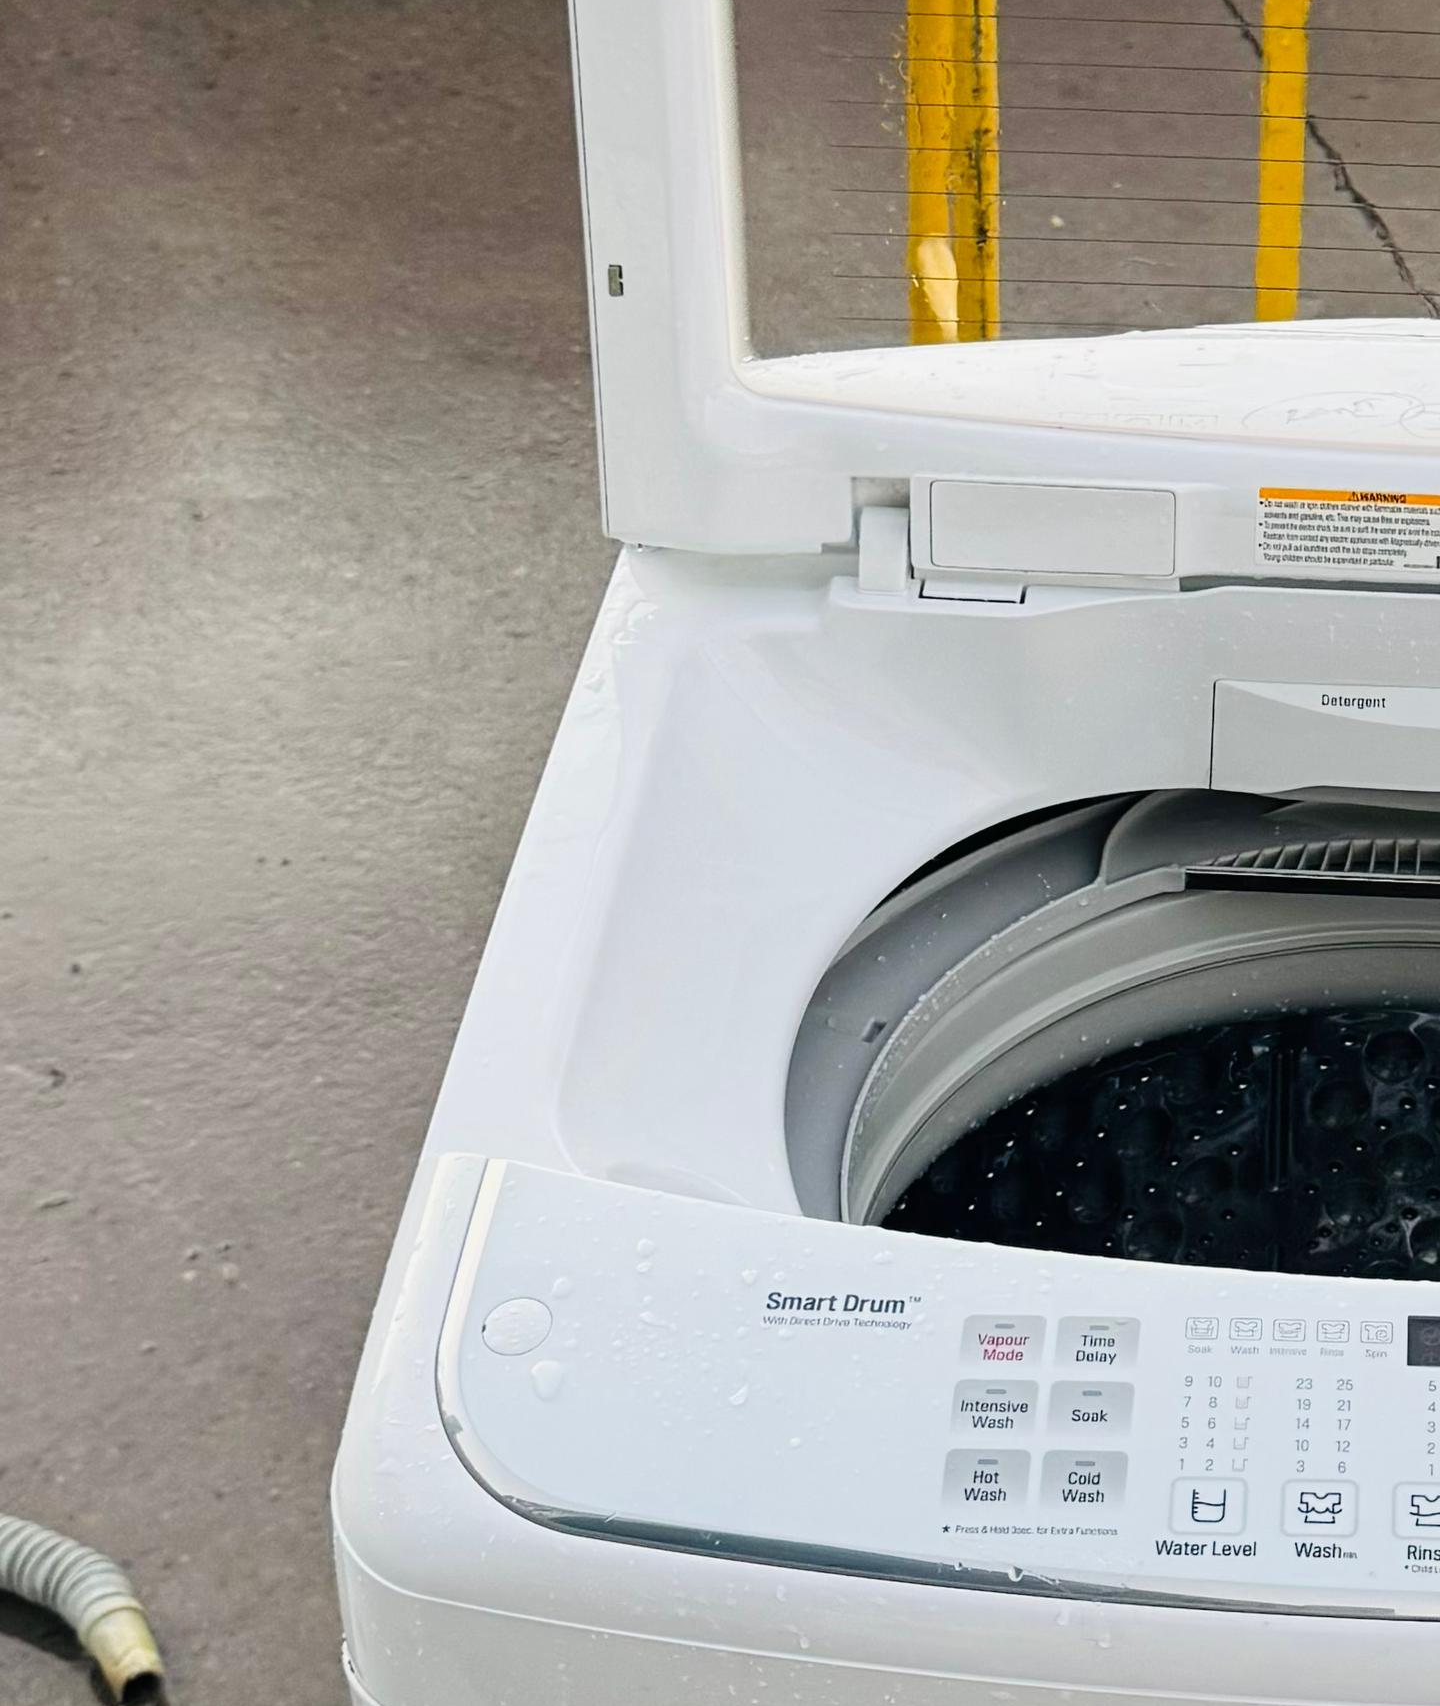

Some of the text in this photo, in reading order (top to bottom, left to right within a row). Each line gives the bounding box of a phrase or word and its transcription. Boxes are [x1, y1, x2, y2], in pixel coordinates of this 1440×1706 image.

[1321, 694, 1386, 709] Detergent
[766, 1292, 837, 1311] Smart
[763, 1315, 912, 1330] With Direct Drive Technology
[978, 1333, 1030, 1348] Vapour
[1081, 1334, 1116, 1347] Time
[983, 1349, 1024, 1361] Mode
[1187, 1344, 1213, 1355] Soak
[1230, 1345, 1260, 1356] Wash
[1365, 1348, 1388, 1359] Spin
[1075, 1350, 1117, 1365] Delay
[1184, 1375, 1223, 1388] 9 10
[1295, 1377, 1354, 1391] 23 25
[1428, 1380, 1437, 1392] 5
[960, 1400, 1029, 1413] Intensive
[1184, 1396, 1218, 1409] 7 8
[1297, 1398, 1352, 1412] 19 21
[1427, 1401, 1436, 1413] 4
[972, 1415, 1014, 1429] Wash
[1071, 1409, 1109, 1422] Soak
[1181, 1416, 1216, 1430] 5 6
[1295, 1417, 1352, 1431] 14 17
[1427, 1421, 1436, 1433] 3
[1178, 1437, 1215, 1449] 3 4
[1295, 1439, 1351, 1453] 10 12
[1427, 1442, 1436, 1455] 2
[1179, 1458, 1214, 1471] 1 2
[1296, 1460, 1347, 1474] 3 6
[1428, 1463, 1434, 1476] 1
[973, 1470, 1000, 1484] Hot
[1068, 1471, 1101, 1485] Cold
[964, 1487, 1007, 1502] Wash
[1061, 1488, 1105, 1503] Wash
[1155, 1540, 1257, 1557] Water Level
[1295, 1542, 1342, 1559] Wash
